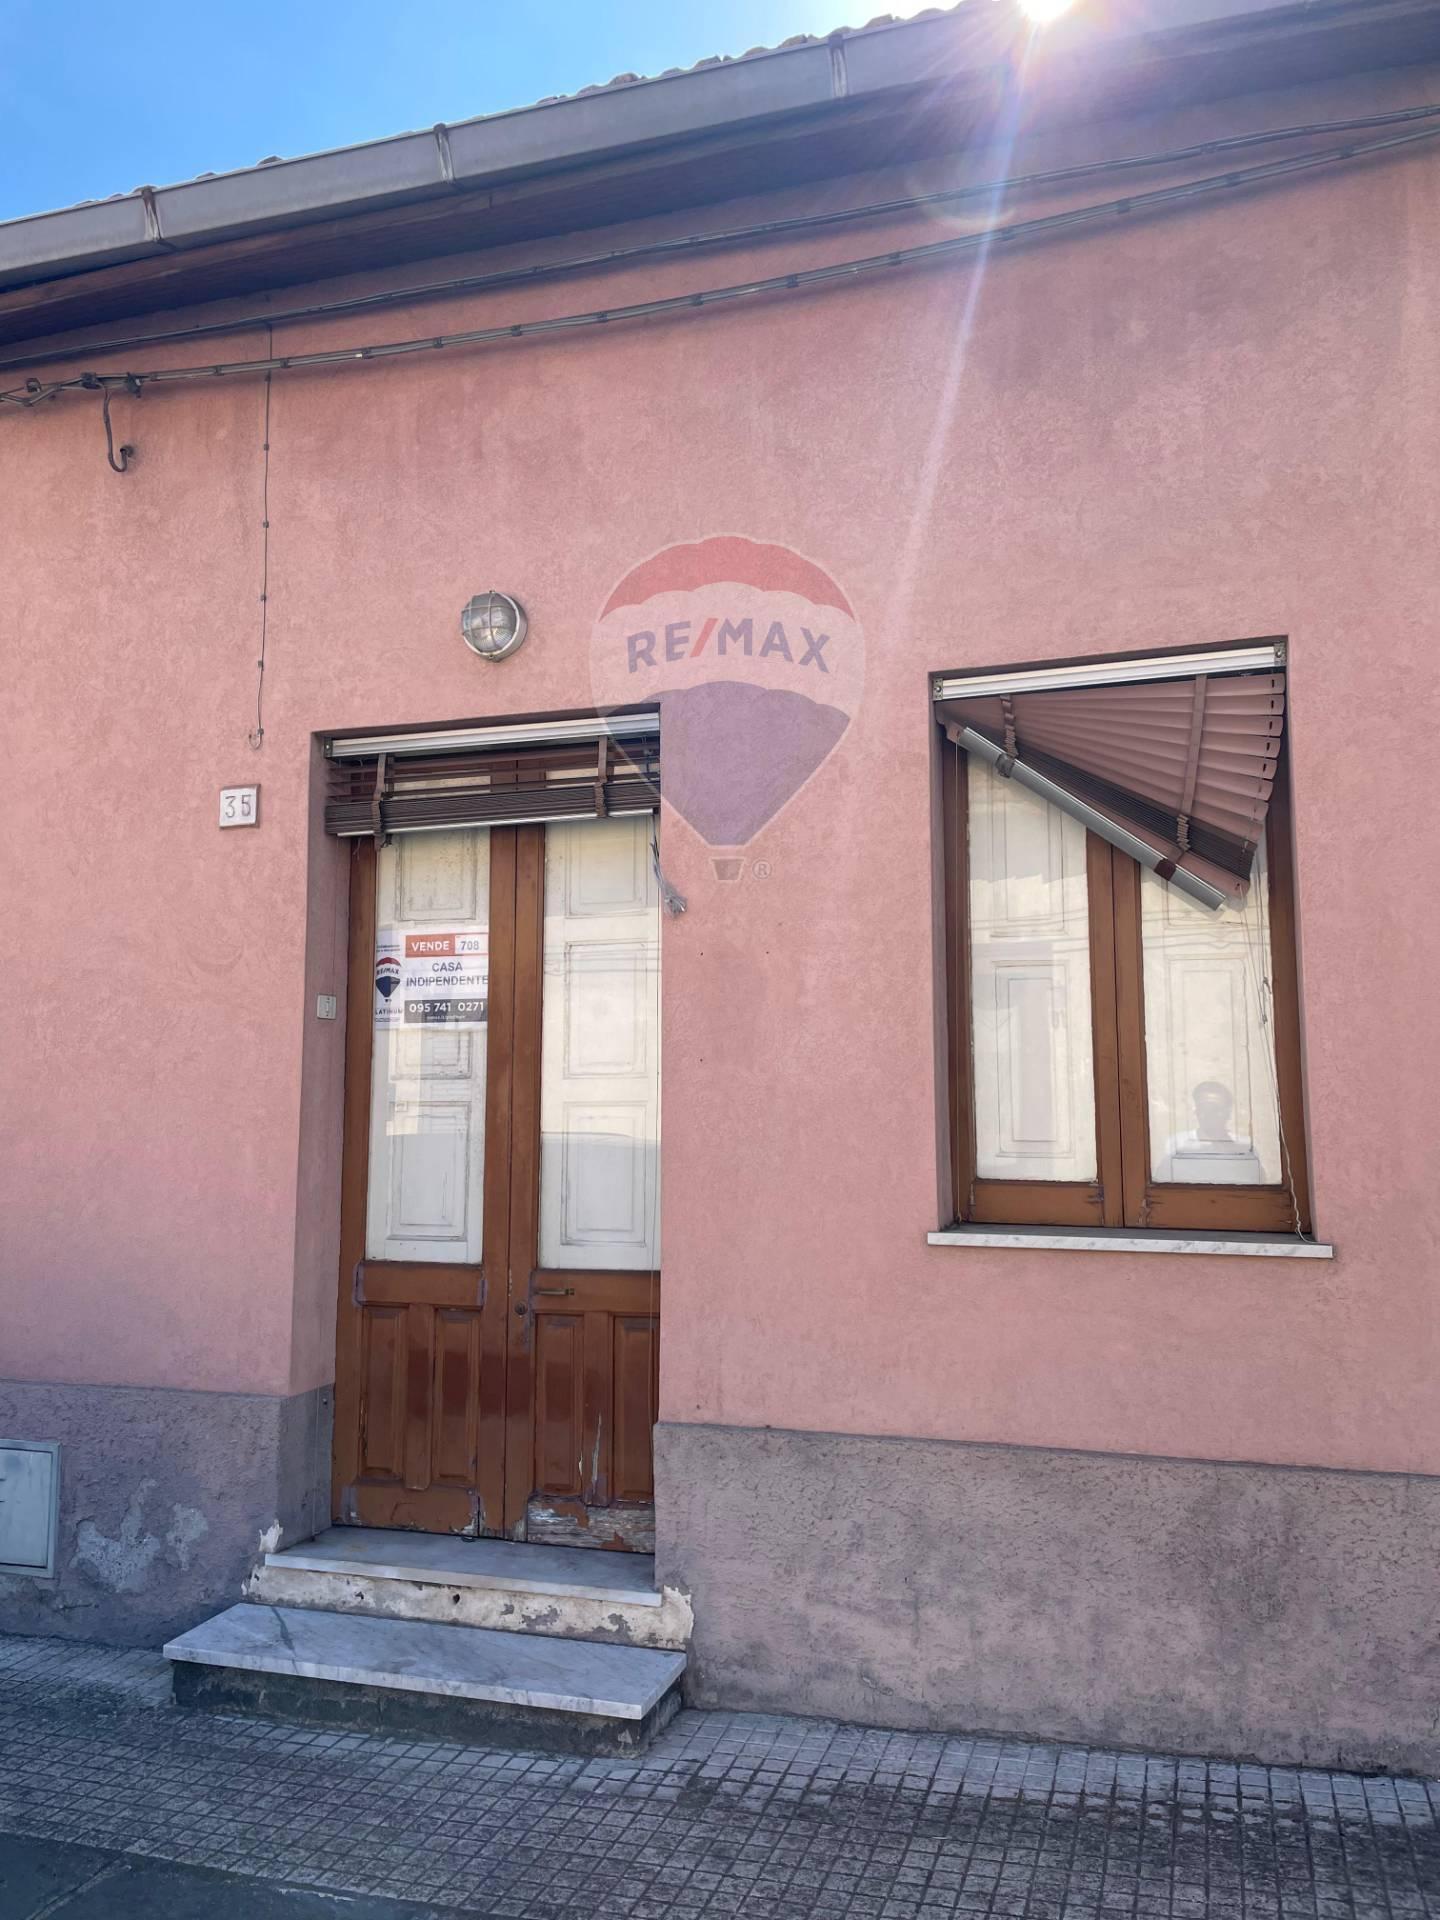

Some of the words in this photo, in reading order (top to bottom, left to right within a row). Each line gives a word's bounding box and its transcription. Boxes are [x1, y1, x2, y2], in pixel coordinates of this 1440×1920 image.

[225, 794, 252, 818] 35
[411, 941, 450, 951] VENDE
[460, 940, 480, 951] 708
[431, 962, 463, 972] CASA
[406, 975, 488, 987] INDIPENDENTE
[409, 1003, 431, 1013] 095
[434, 1002, 452, 1012] 741
[457, 1001, 484, 1012] 0271
